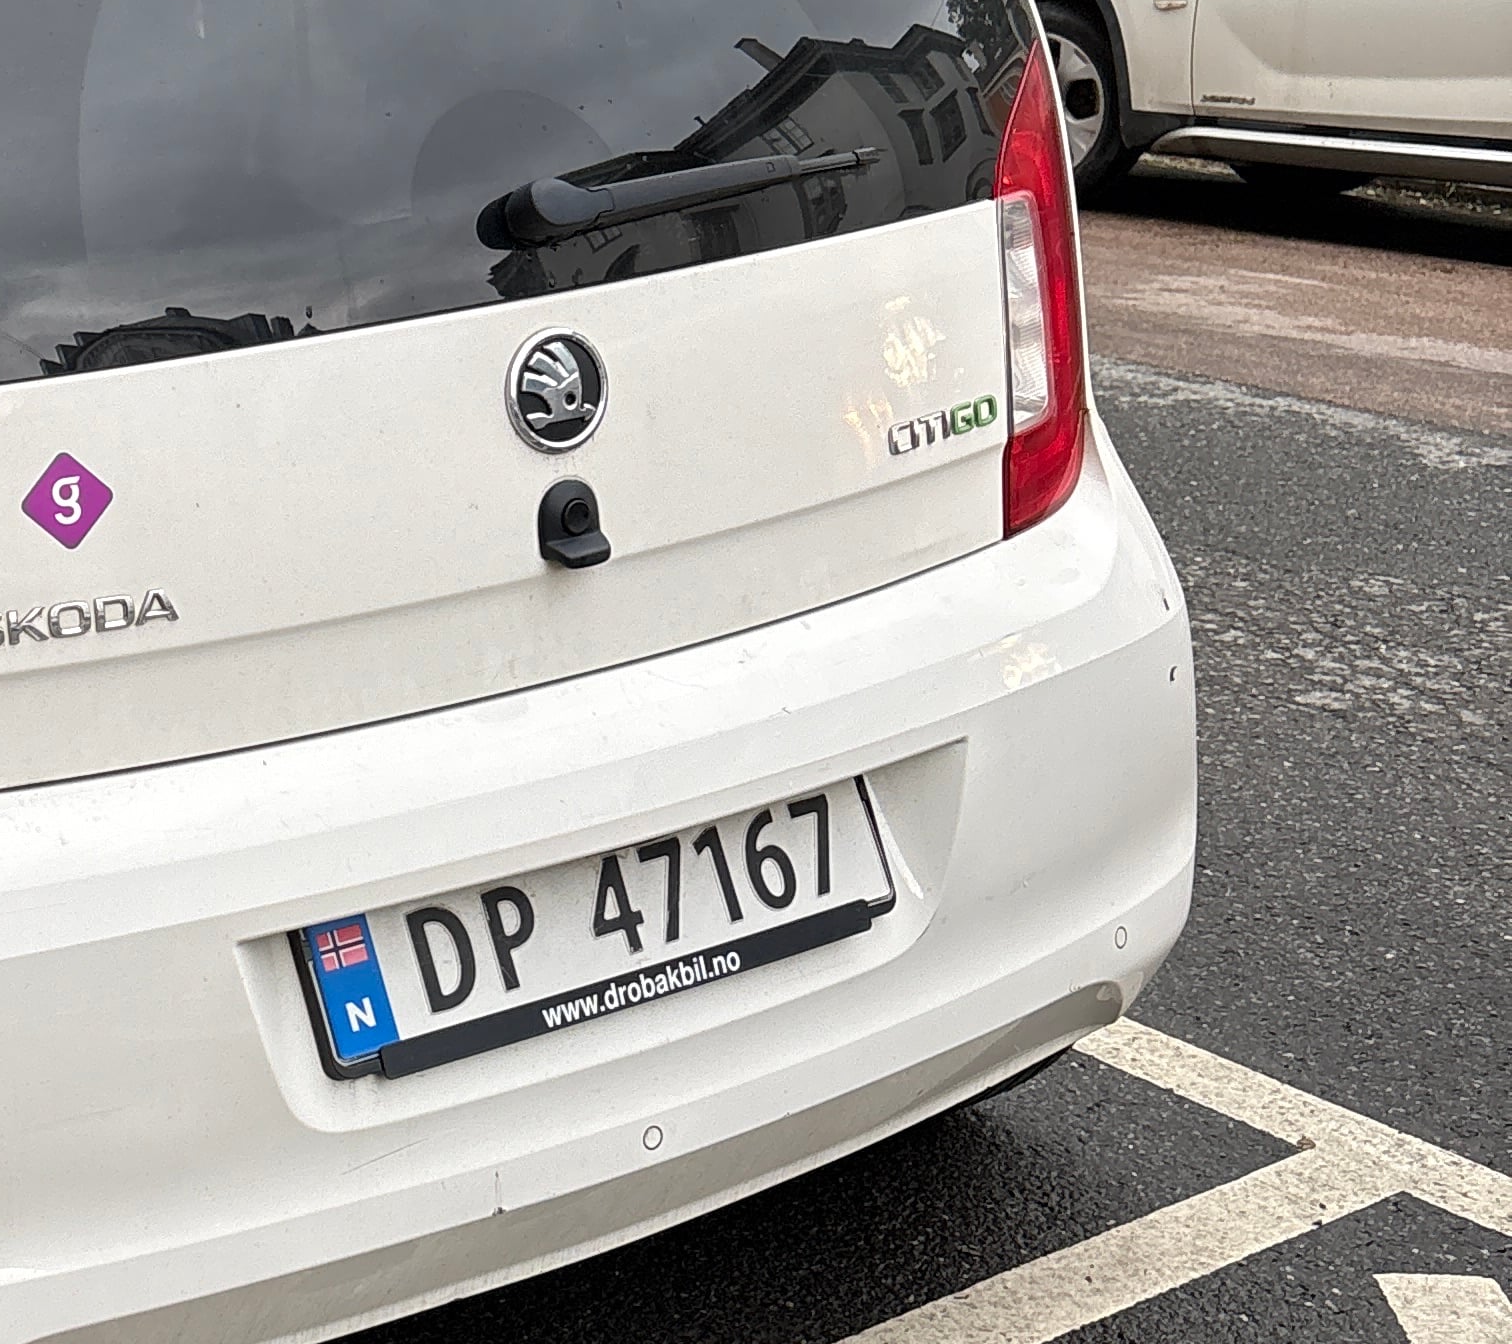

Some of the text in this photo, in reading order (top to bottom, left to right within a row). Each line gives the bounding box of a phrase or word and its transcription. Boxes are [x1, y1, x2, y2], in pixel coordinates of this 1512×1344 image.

[887, 394, 998, 455] CITIGO
[51, 475, 82, 525] g
[403, 792, 831, 1014] DP 47167
[345, 997, 377, 1032] N
[541, 950, 742, 1029] www.drobakbil.no
